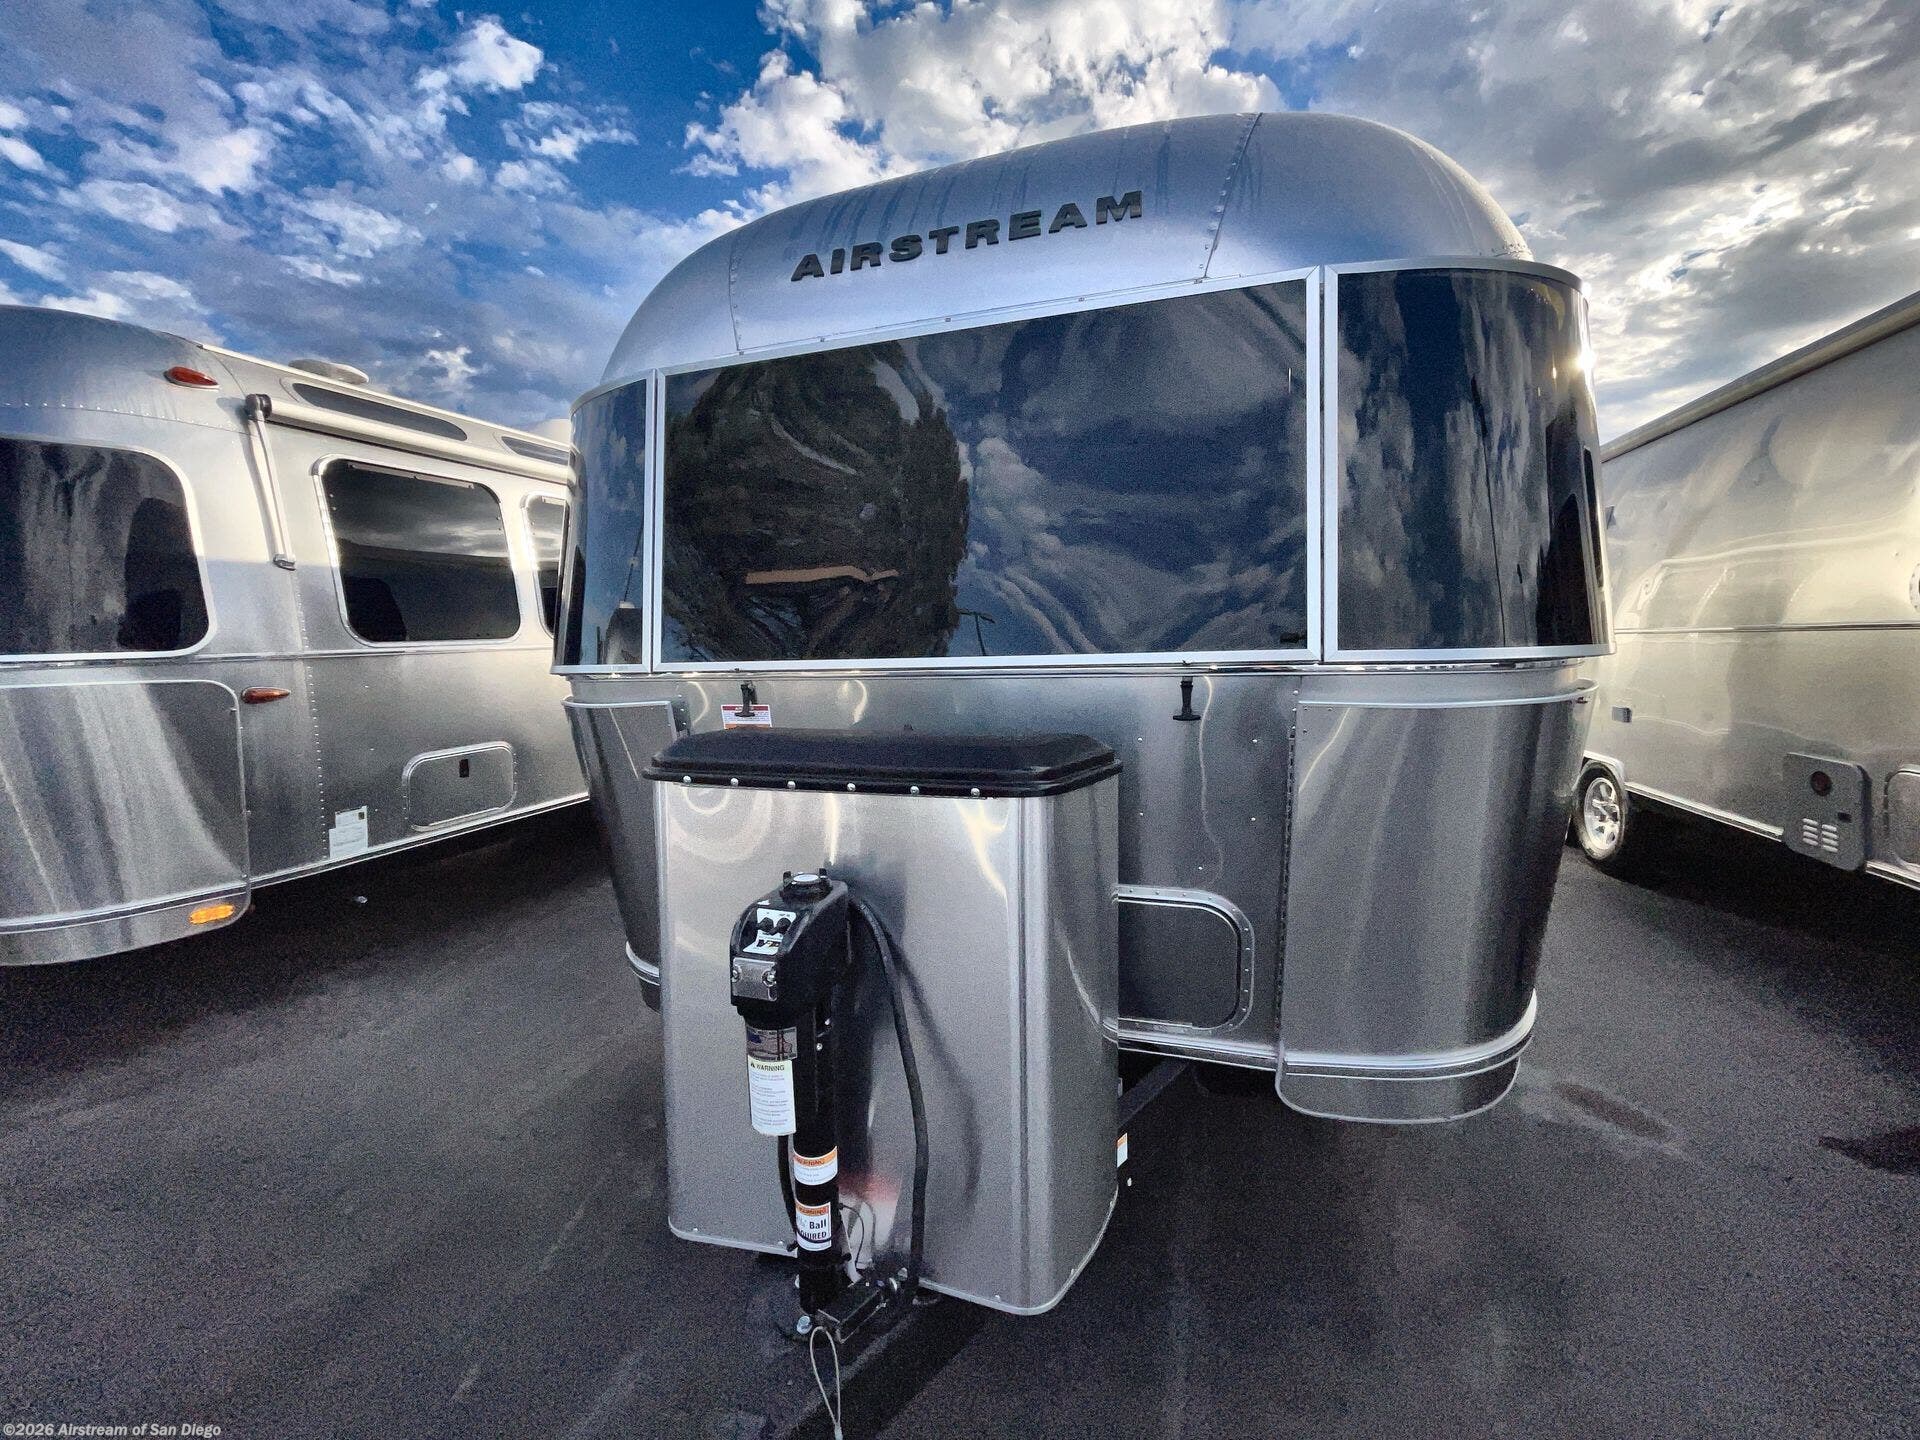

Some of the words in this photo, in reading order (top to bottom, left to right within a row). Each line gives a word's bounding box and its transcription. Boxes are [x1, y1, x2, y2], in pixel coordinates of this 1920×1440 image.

[790, 190, 1143, 282] AIRSTREAM
[756, 1064, 785, 1072] WARNING
[809, 1218, 827, 1229] Ball
